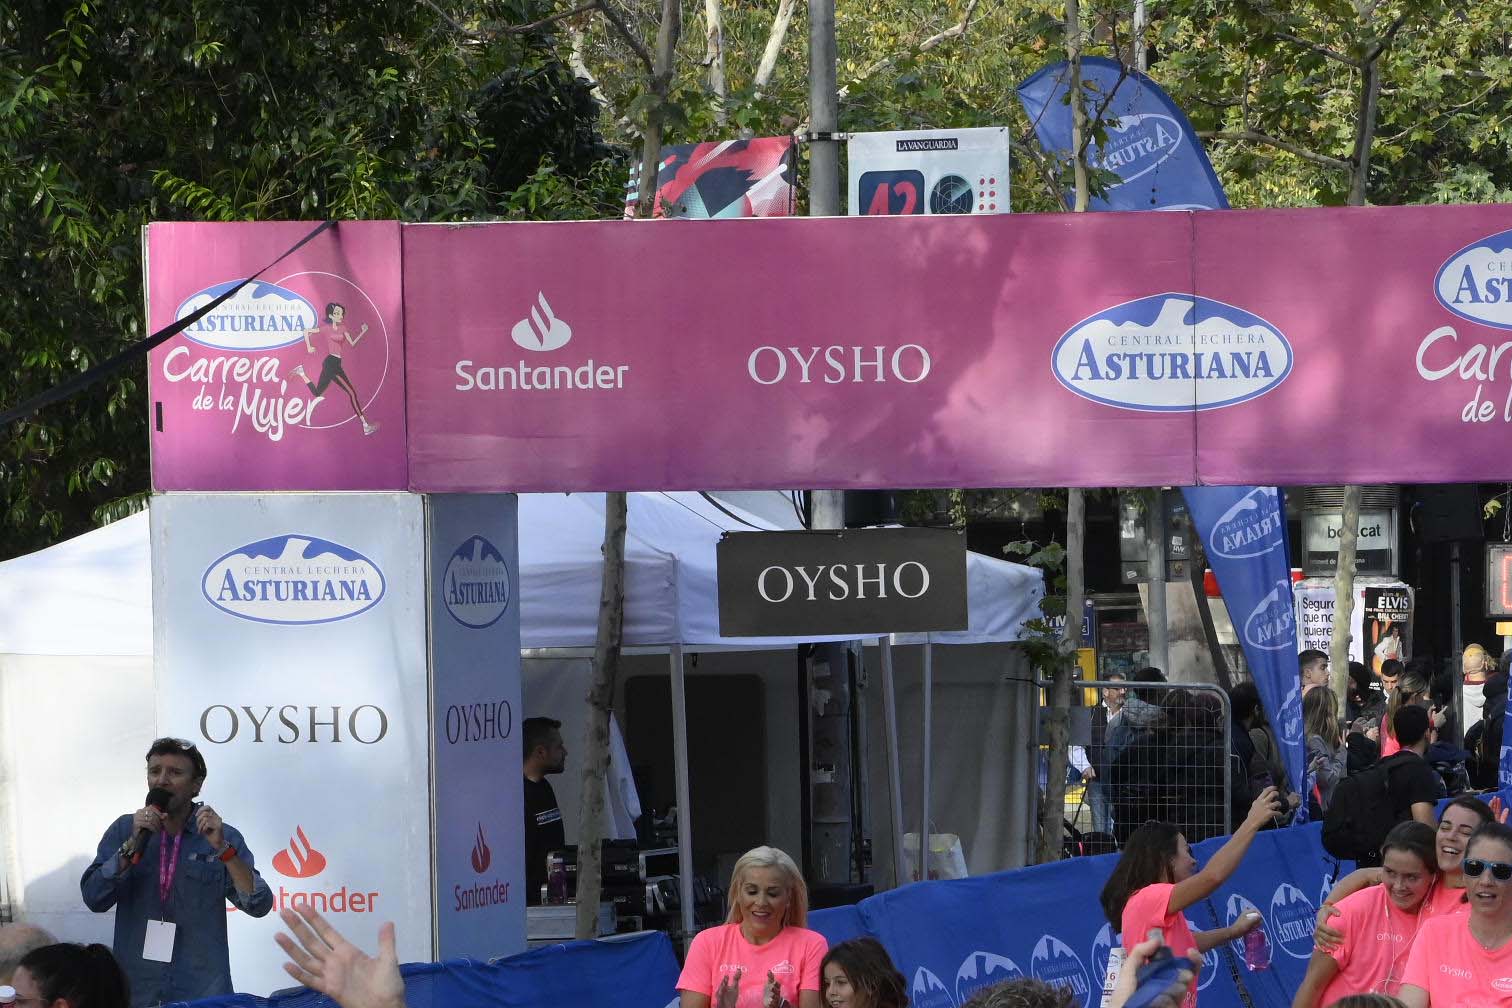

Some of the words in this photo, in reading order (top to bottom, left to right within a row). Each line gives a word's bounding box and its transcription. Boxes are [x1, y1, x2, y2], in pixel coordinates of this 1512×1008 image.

[1107, 335, 1183, 346] CENTRAL
[1192, 334, 1266, 346] LECHERA
[162, 346, 280, 383] Carrera
[455, 361, 628, 391] Santander
[748, 344, 931, 385] OYSHO
[1071, 337, 1273, 382] ASTURIANA
[192, 388, 213, 410] de
[218, 389, 233, 410] la
[232, 377, 324, 441] Mujer
[1461, 385, 1495, 422] de
[217, 568, 372, 602] ASTURIANA
[244, 566, 301, 575] CENTRAL
[308, 566, 365, 575] LECHERA
[449, 571, 506, 605] ASTURIANA
[757, 561, 930, 603] OYSHO
[1304, 613, 1319, 625] que
[1378, 597, 1408, 608] ELVIS
[199, 704, 388, 744] OYSHO
[446, 700, 511, 745] OYSHO
[454, 878, 510, 912] Santander
